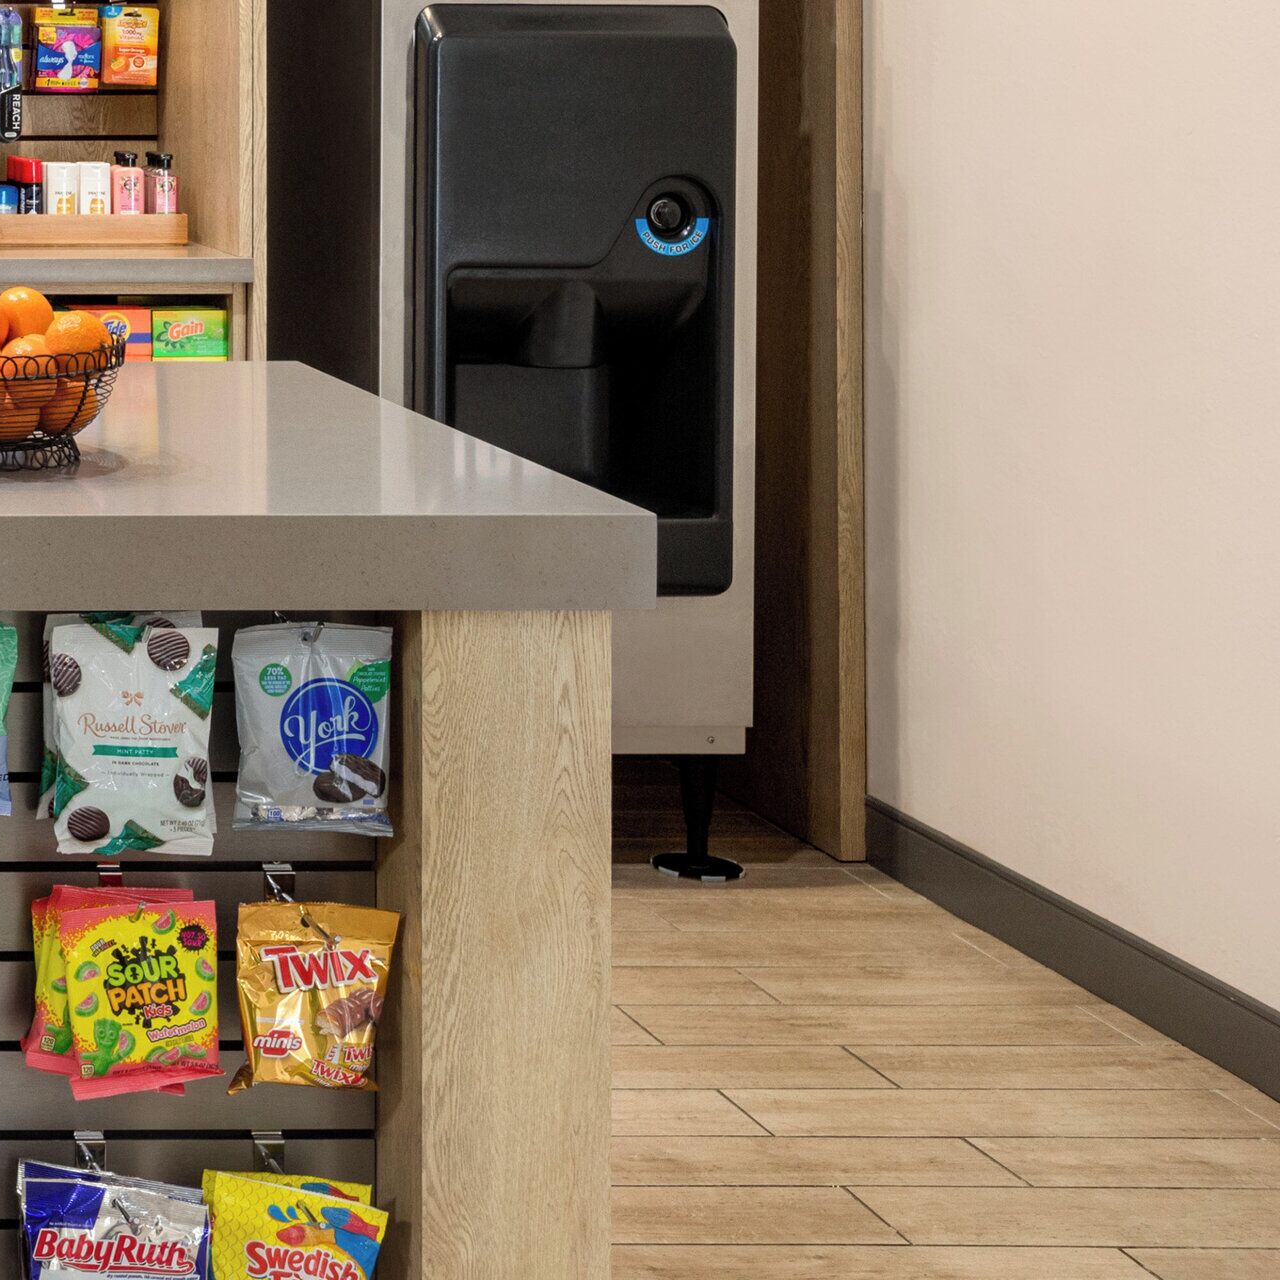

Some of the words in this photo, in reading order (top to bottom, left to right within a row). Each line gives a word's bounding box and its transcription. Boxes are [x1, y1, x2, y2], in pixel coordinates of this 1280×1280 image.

[39, 55, 64, 64] always
[11, 94, 21, 130] REACH
[641, 229, 667, 255] PUSH
[669, 242, 690, 255] FOR
[688, 229, 705, 252] ICE
[168, 321, 204, 339] Gain
[265, 666, 285, 676] 70%
[78, 712, 137, 735] Russell
[139, 713, 187, 735] Stover
[284, 696, 360, 777] York
[107, 956, 178, 987] SOUR
[260, 945, 380, 993] TWIX
[108, 978, 186, 1012] PATCH
[144, 1004, 173, 1018] Kids
[147, 1018, 206, 1043] Watermelon
[253, 1034, 302, 1050] minis
